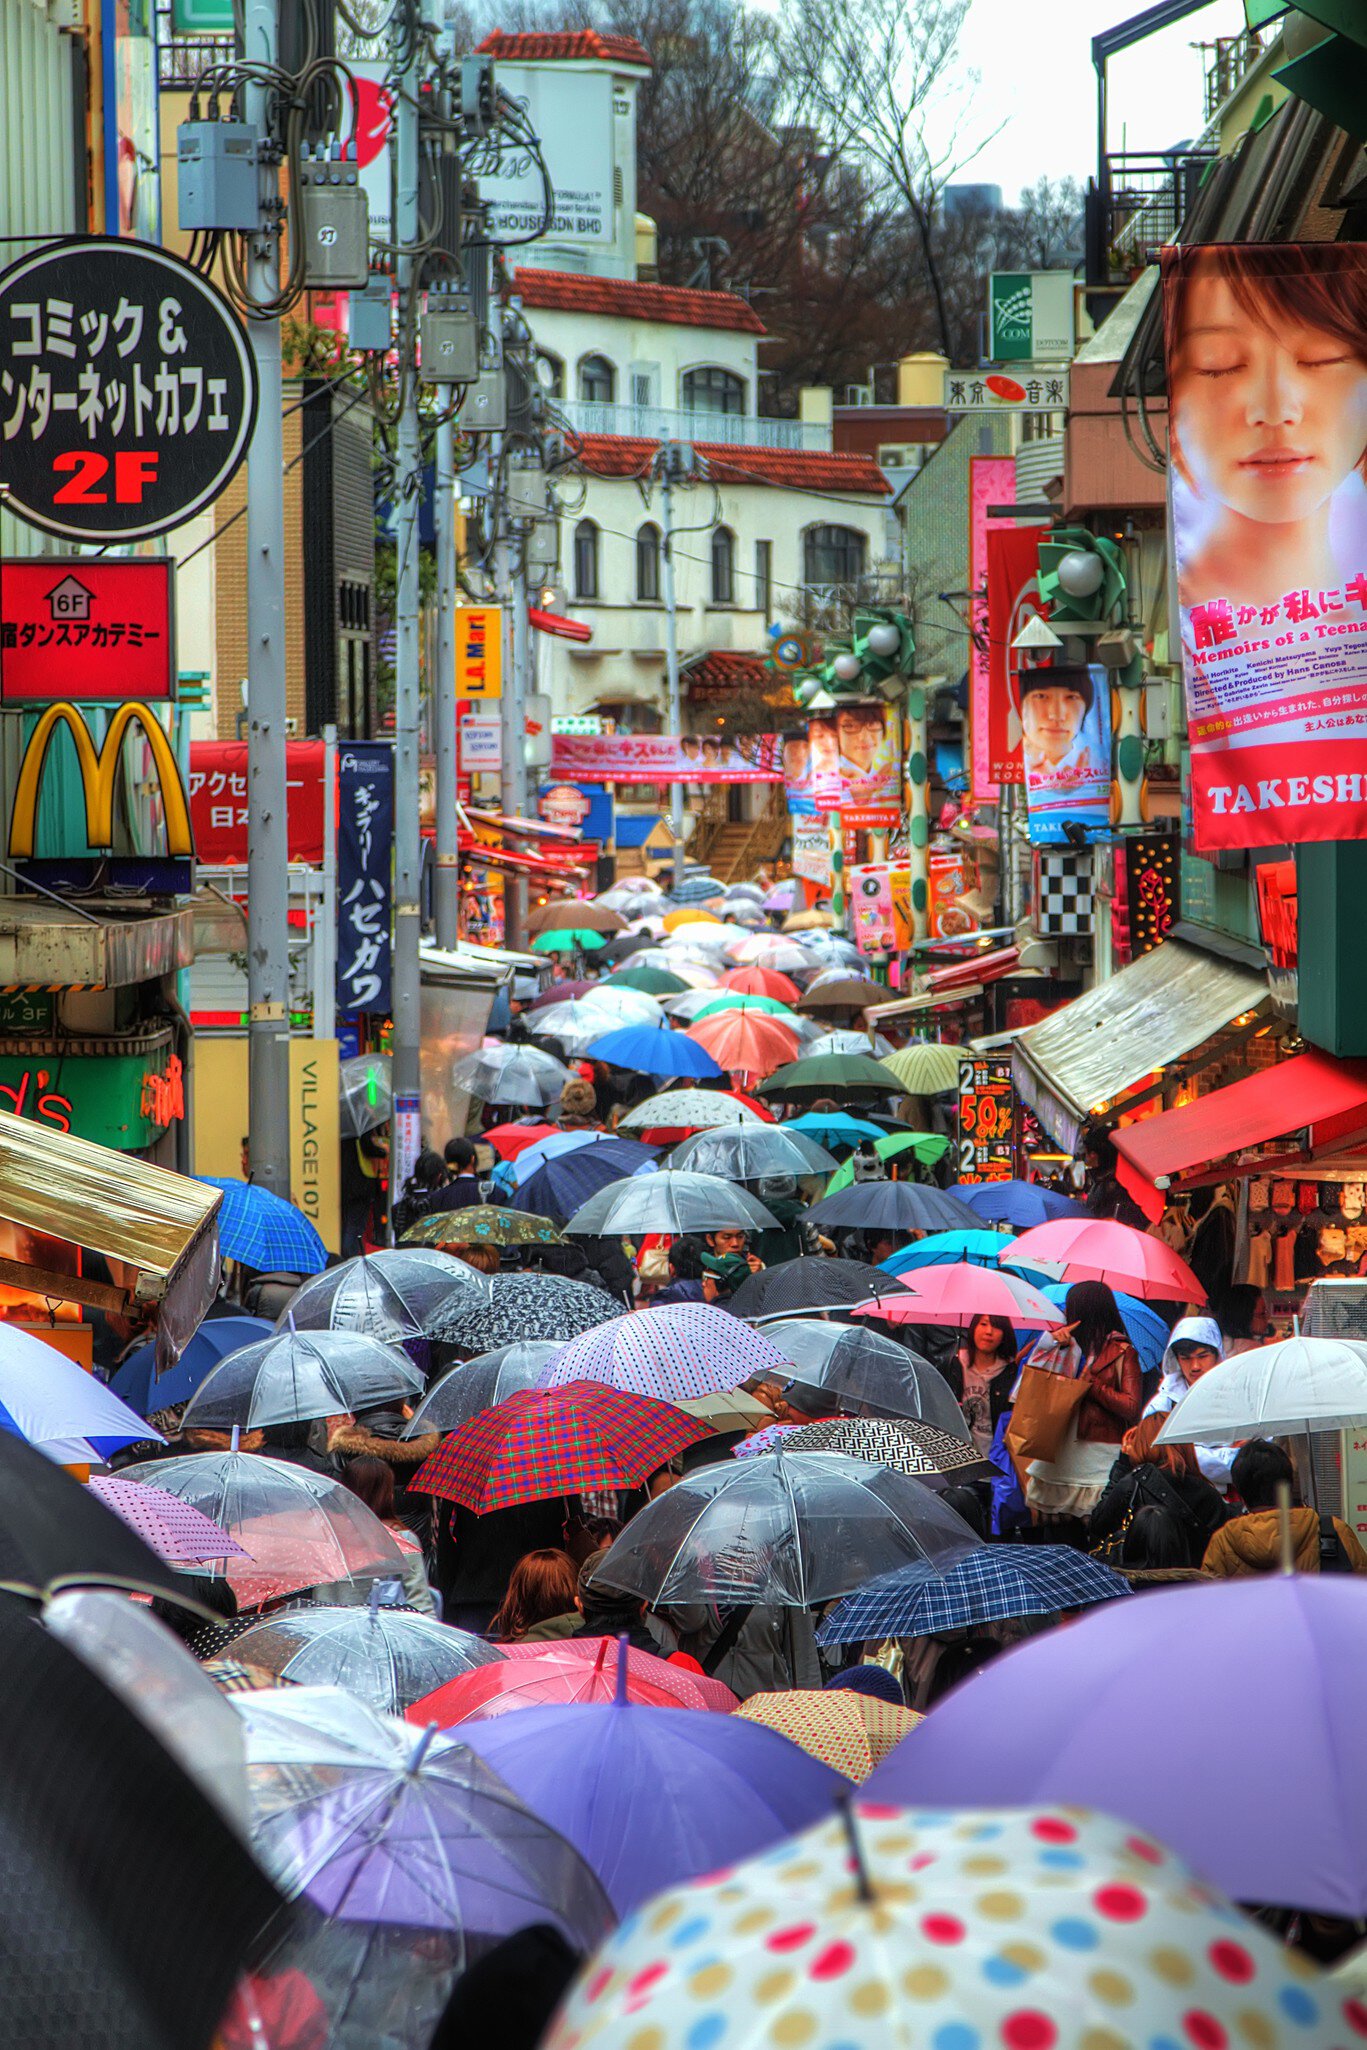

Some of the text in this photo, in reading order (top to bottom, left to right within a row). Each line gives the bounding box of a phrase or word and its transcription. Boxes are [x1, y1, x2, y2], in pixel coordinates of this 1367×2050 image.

[578, 217, 602, 234] BHD
[10, 297, 188, 358] コミック &
[2, 362, 229, 441] ンターネットカフェ
[950, 380, 1063, 404] 東京 音楽
[53, 451, 159, 504] 2F
[57, 594, 84, 612] 6F
[466, 615, 486, 658] Mart
[1192, 640, 1270, 666] Memoirs
[1275, 632, 1295, 646] of
[1300, 631, 1310, 641] a
[1211, 667, 1239, 678] Horikita
[1247, 658, 1273, 669] Kenichi
[1275, 651, 1317, 662] Matsuyama
[1275, 671, 1284, 679] by
[1287, 666, 1310, 676] Hans
[1313, 660, 1347, 670] Canosa
[340, 783, 389, 1008] ギャラリー ハセガワ
[22, 1007, 48, 1020] 3F
[960, 1062, 975, 1094] 2
[961, 1095, 1012, 1131] 50%
[302, 1061, 319, 1219] VILLAGE 107
[961, 1139, 976, 1172] 2
